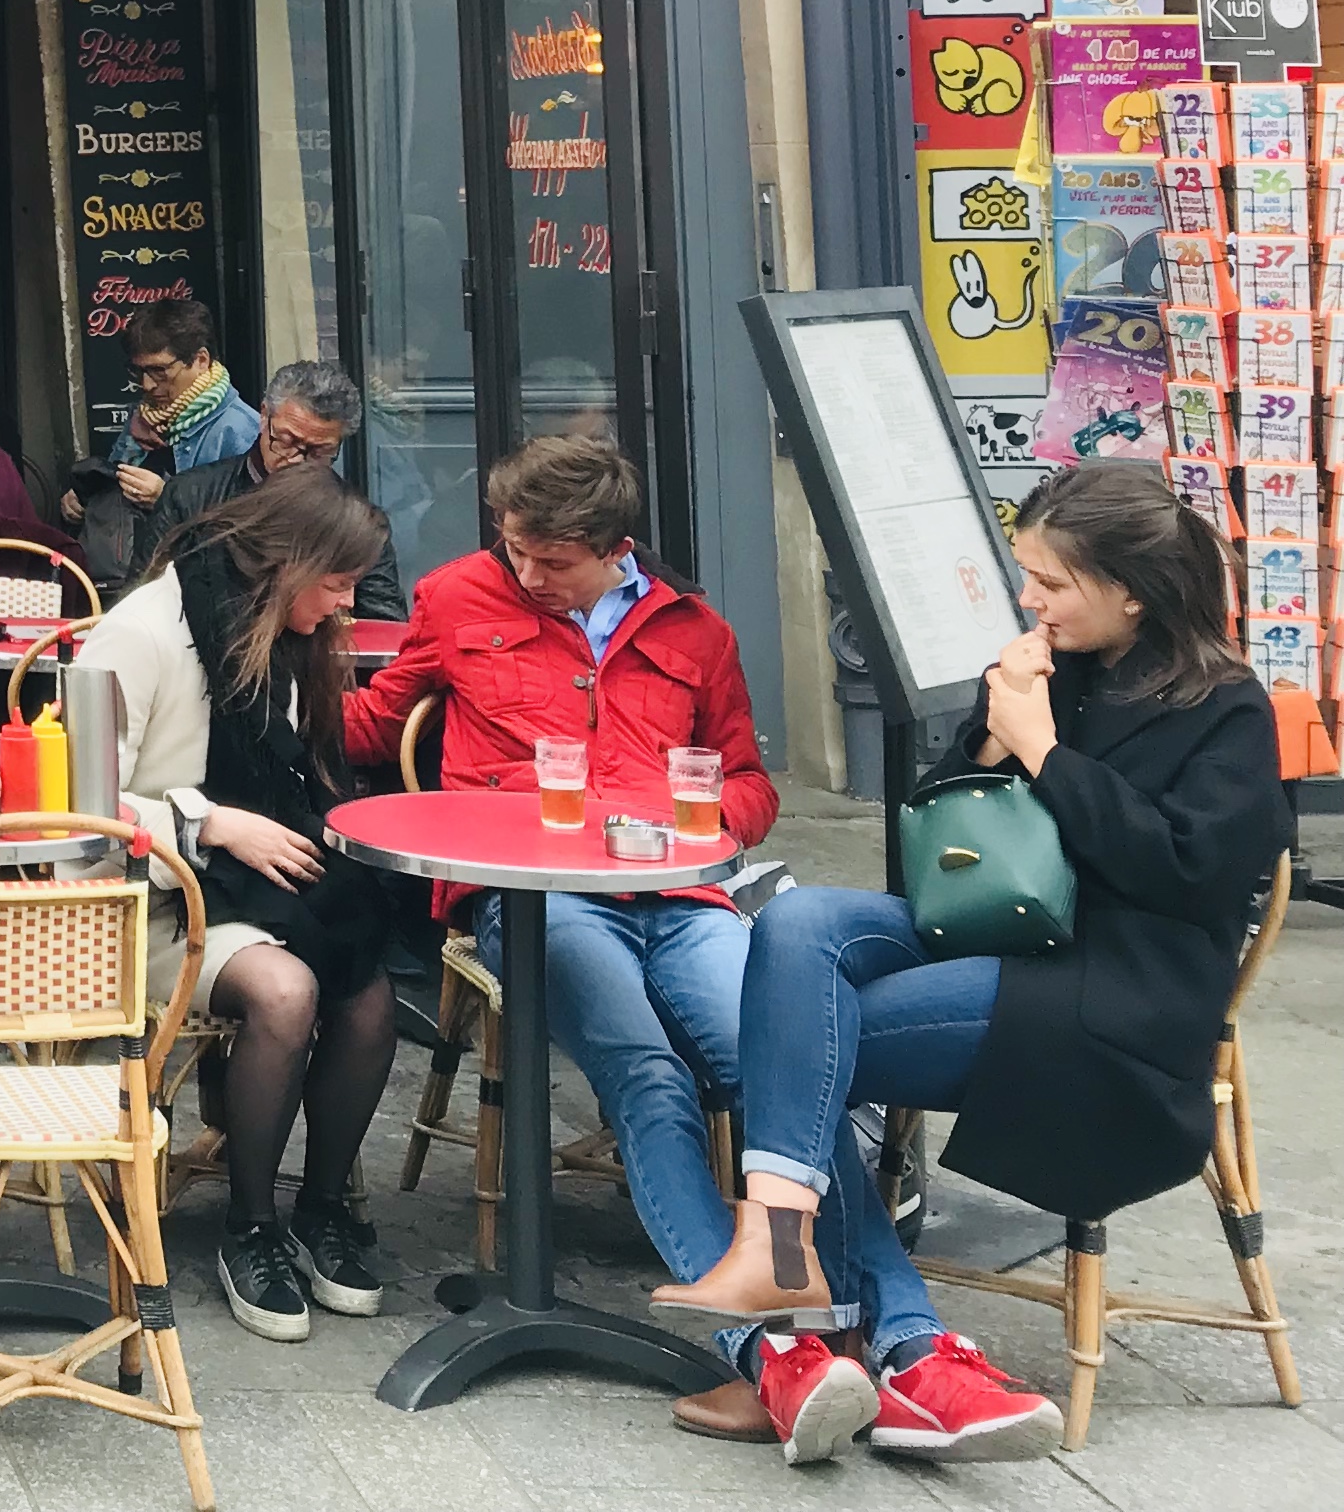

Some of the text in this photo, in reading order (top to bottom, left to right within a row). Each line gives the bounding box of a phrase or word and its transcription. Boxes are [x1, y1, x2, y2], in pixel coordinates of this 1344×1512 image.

[78, 27, 182, 69] Pizza
[1086, 38, 1197, 62] 1 AN DE PLUS
[86, 58, 187, 89] Maison
[1174, 93, 1201, 118] 22
[1250, 92, 1290, 119] 35
[74, 122, 203, 155] BURGERS
[1061, 170, 1094, 189] 20
[1174, 166, 1203, 194] 23
[1253, 168, 1292, 195] 36
[82, 194, 207, 239] SNACKS
[1109, 203, 1158, 215] PERDRE
[1174, 240, 1205, 267] 26
[1255, 244, 1296, 269] 37
[1077, 310, 1161, 352] 20
[1176, 314, 1207, 340] 27
[1253, 319, 1295, 346] 38
[1177, 389, 1208, 416] 28
[1256, 393, 1296, 419] 39
[1181, 464, 1210, 489] 32
[1263, 472, 1297, 498] 41
[1261, 548, 1304, 574] 42
[1263, 625, 1302, 649] 43
